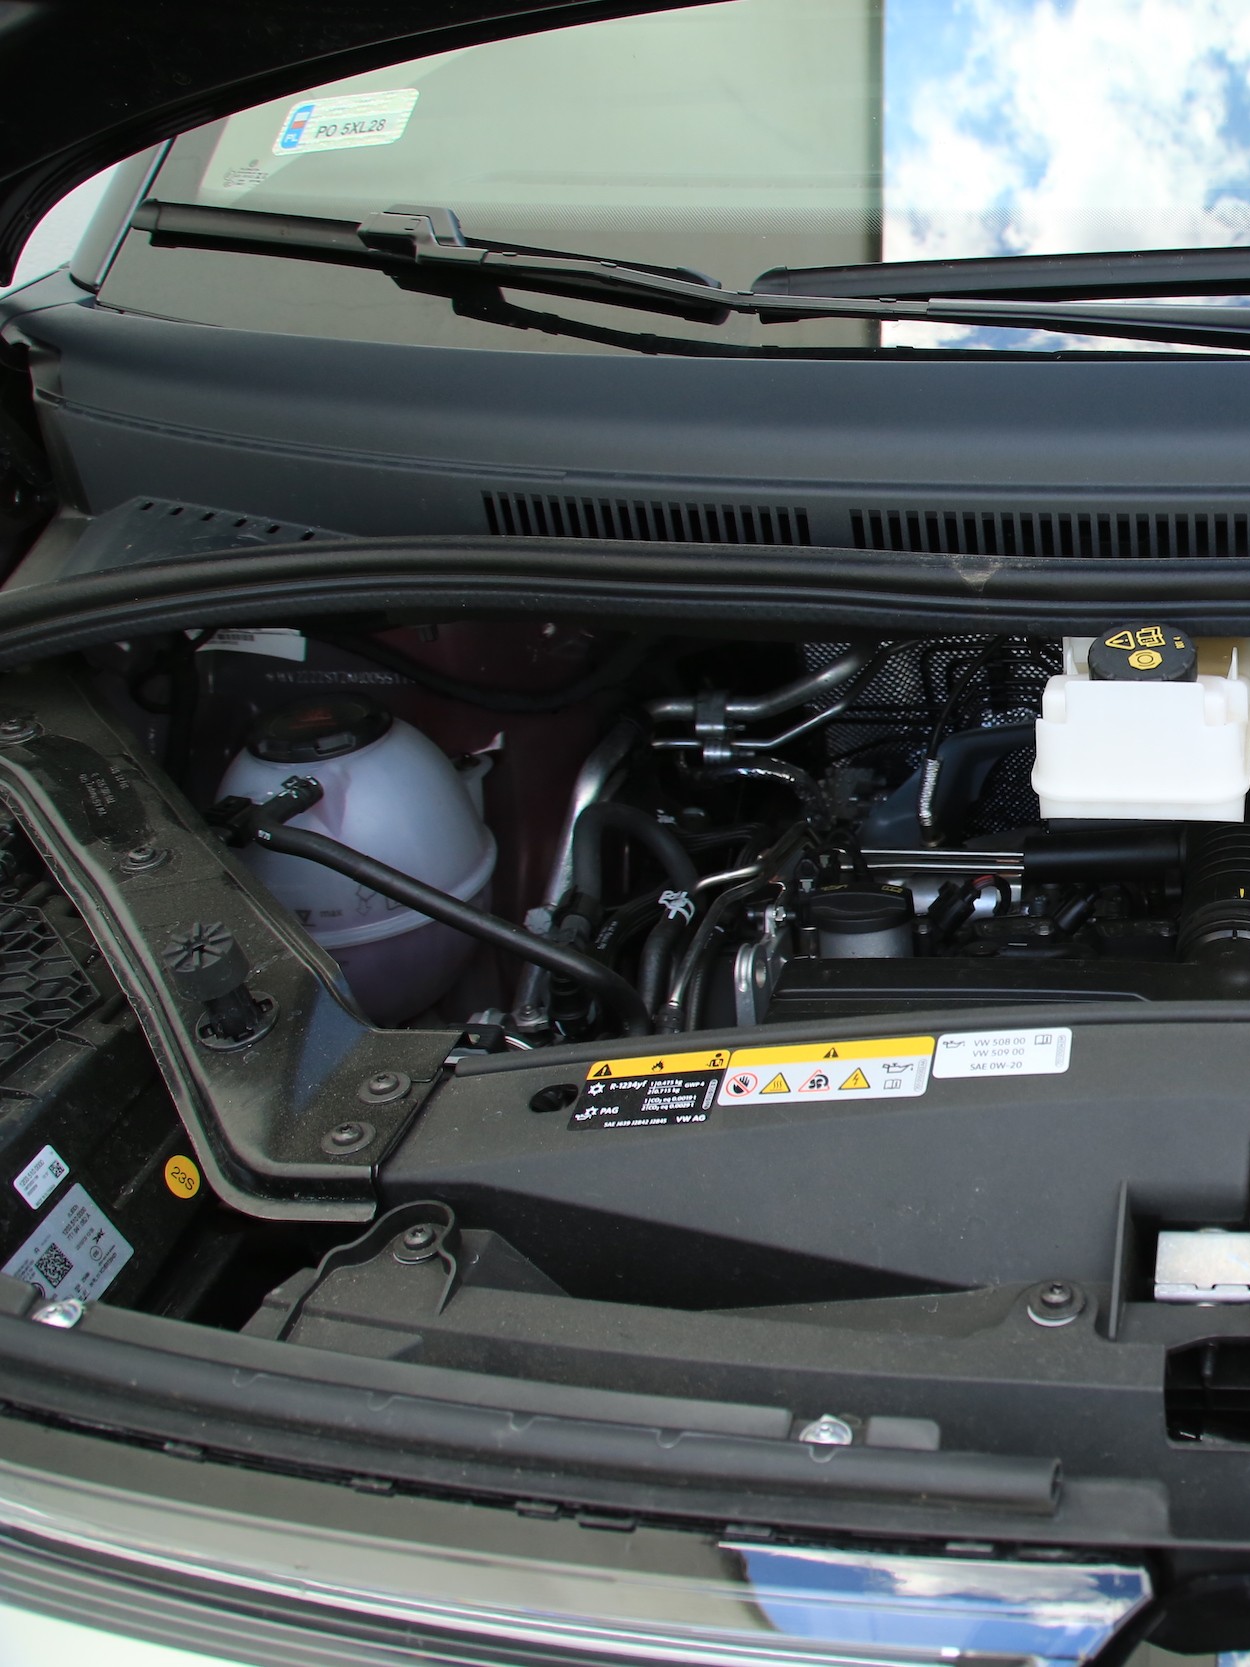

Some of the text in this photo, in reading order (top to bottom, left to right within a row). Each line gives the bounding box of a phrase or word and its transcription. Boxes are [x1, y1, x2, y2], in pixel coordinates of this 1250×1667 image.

[315, 118, 387, 139] PO 5XL28
[320, 909, 342, 918] max
[974, 1037, 1026, 1047] VW 508 00
[972, 1048, 1025, 1057] VW 509 00
[970, 1061, 1022, 1071] SAE 0W-20
[610, 1080, 648, 1090] R-1234yf
[600, 1106, 619, 1115] PAG
[676, 1114, 706, 1123] VW AG
[171, 1166, 195, 1191] 23S
